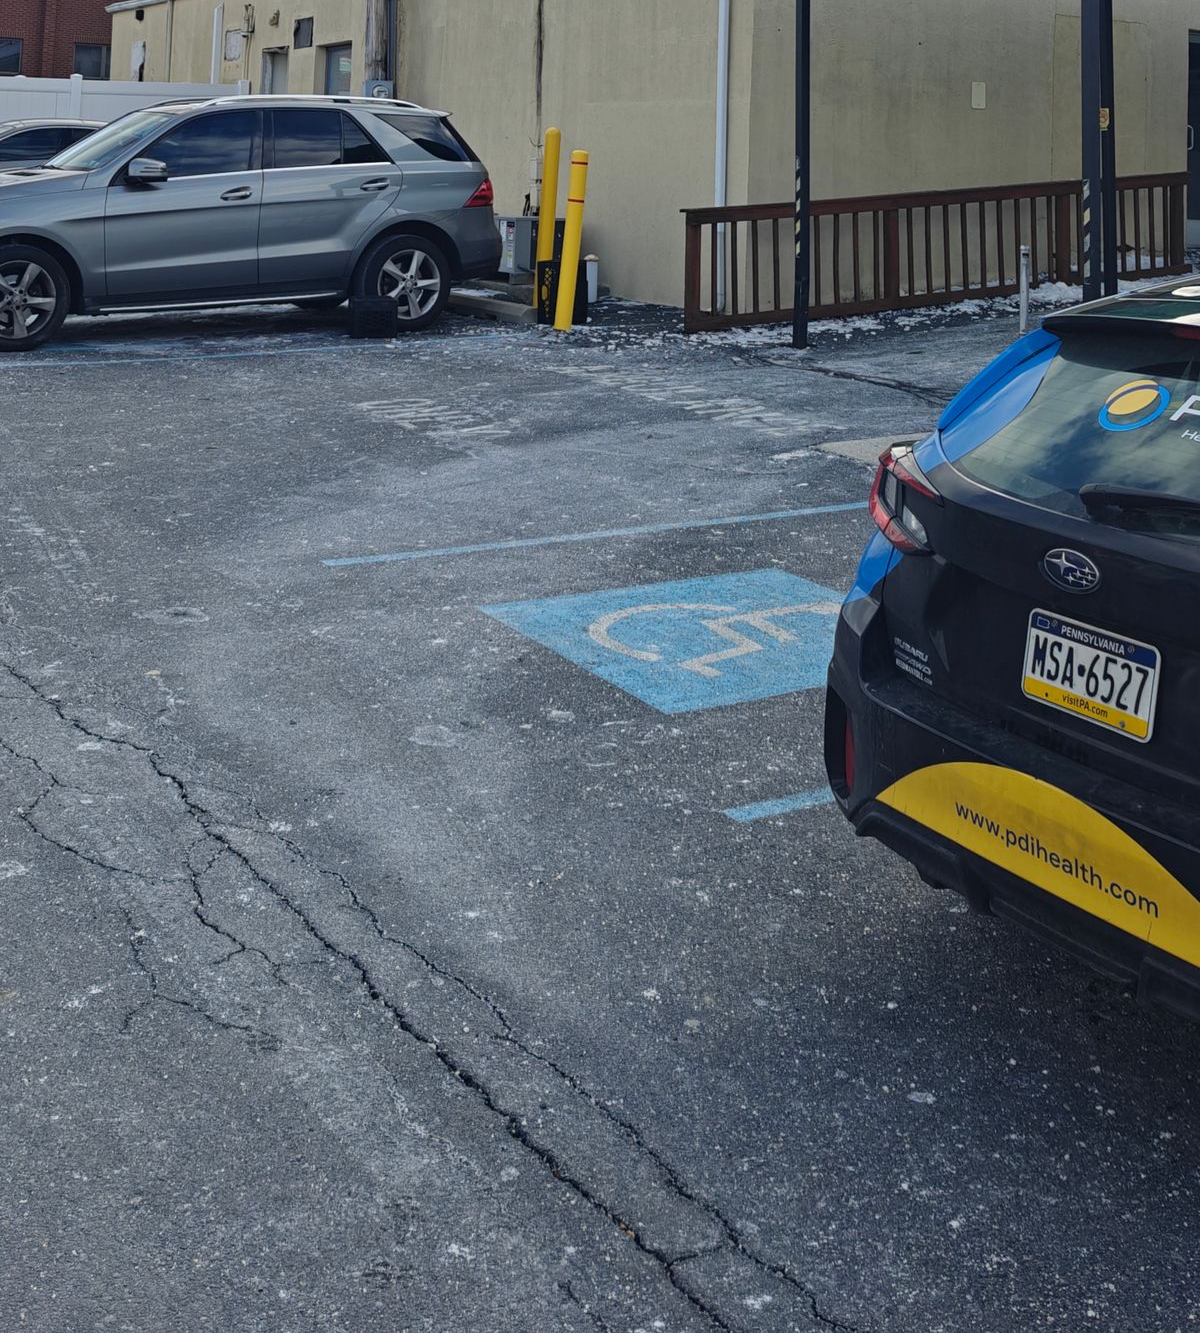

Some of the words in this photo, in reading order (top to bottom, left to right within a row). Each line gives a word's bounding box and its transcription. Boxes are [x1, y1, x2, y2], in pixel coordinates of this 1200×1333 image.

[1061, 625, 1125, 655] PENNSYLVANIA
[1062, 693, 1108, 719] visitPA.com
[955, 801, 1159, 919] www.pdihealth.com
